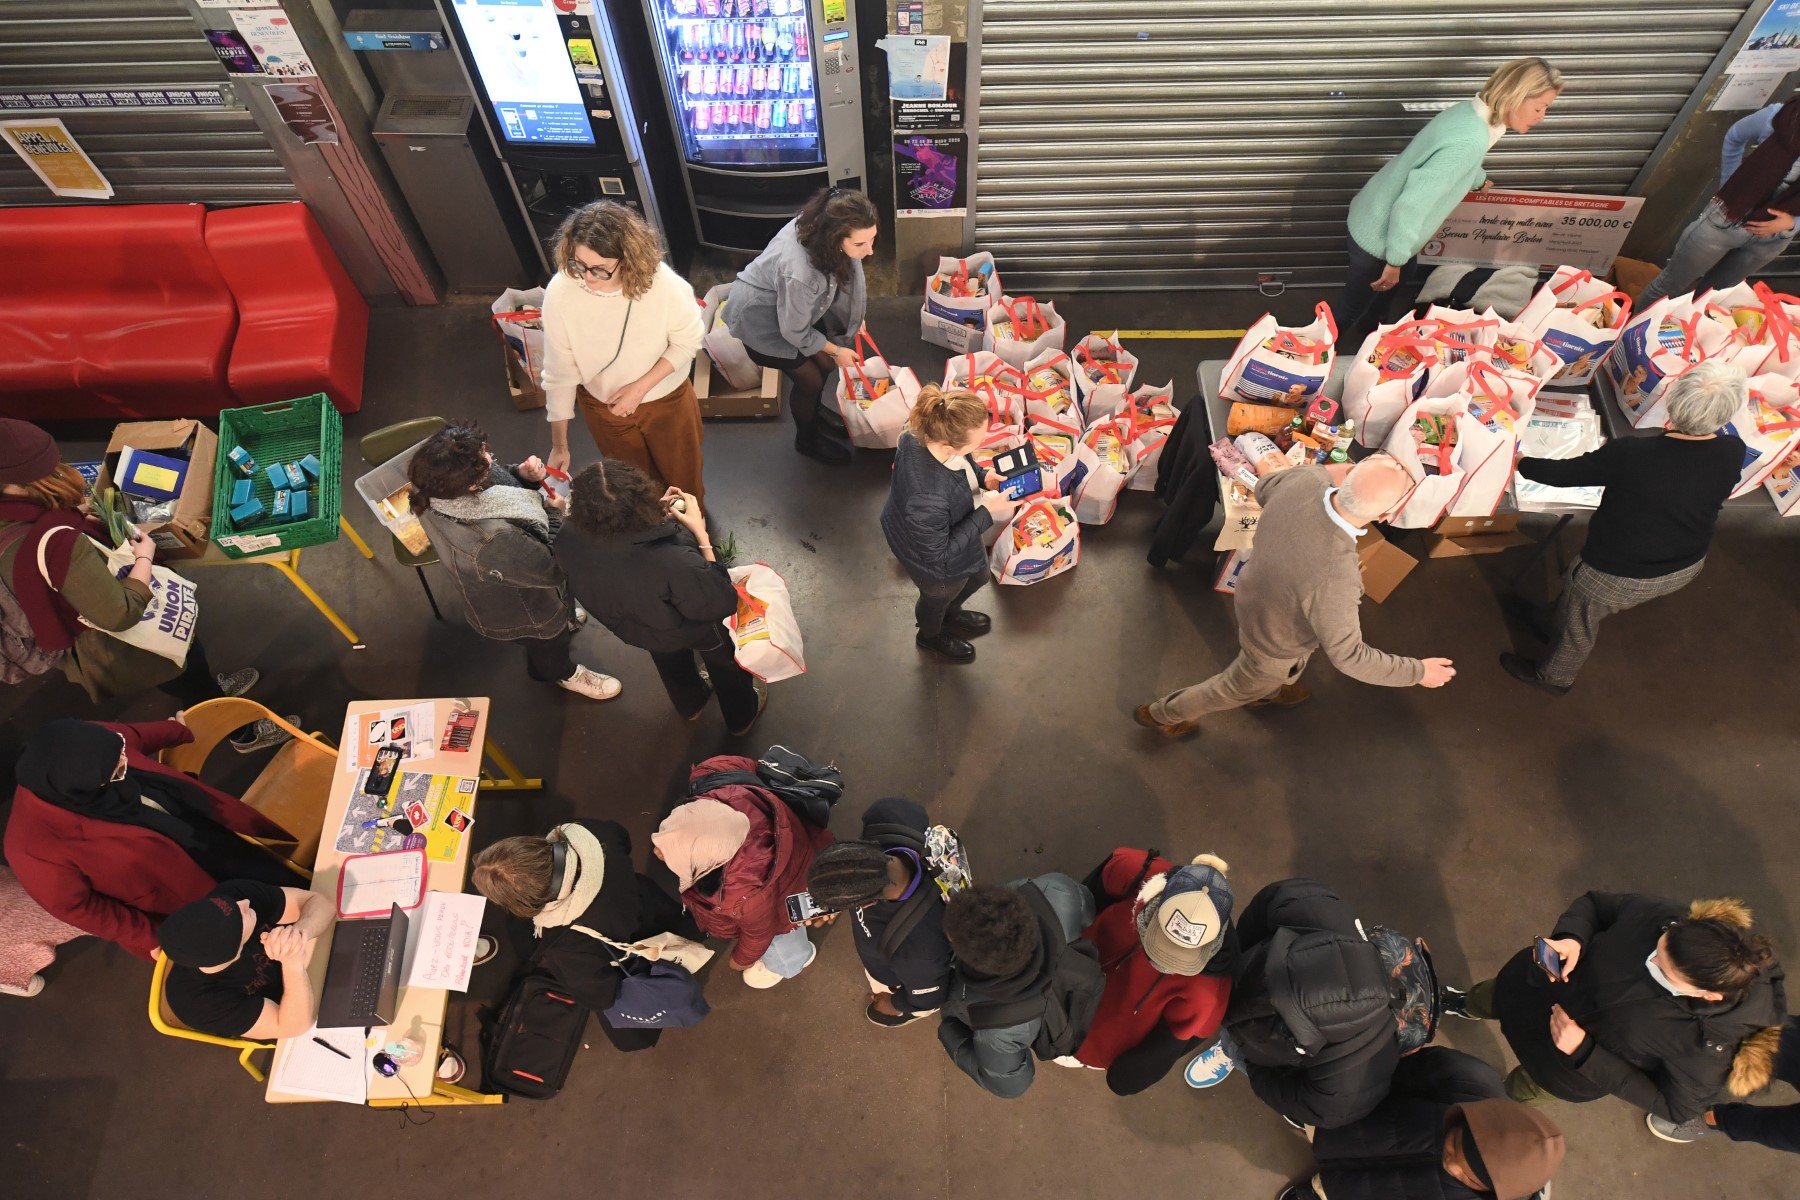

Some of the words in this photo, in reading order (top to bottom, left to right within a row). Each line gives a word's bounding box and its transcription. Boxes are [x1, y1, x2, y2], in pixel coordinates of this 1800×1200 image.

[12, 130, 50, 143] APPEL
[1499, 217, 1516, 230] cinq
[1516, 217, 1535, 227] mille
[1535, 221, 1554, 229] euros
[1561, 216, 1576, 225] 35
[1578, 218, 1619, 229] 000,00
[1622, 221, 1633, 229] €
[1436, 226, 1469, 239] Secours
[1472, 228, 1511, 244] Populaire
[1513, 231, 1543, 244] Breton
[1240, 469, 1257, 483] Signal
[158, 578, 180, 633] UNION
[174, 585, 196, 640] PIRATE
